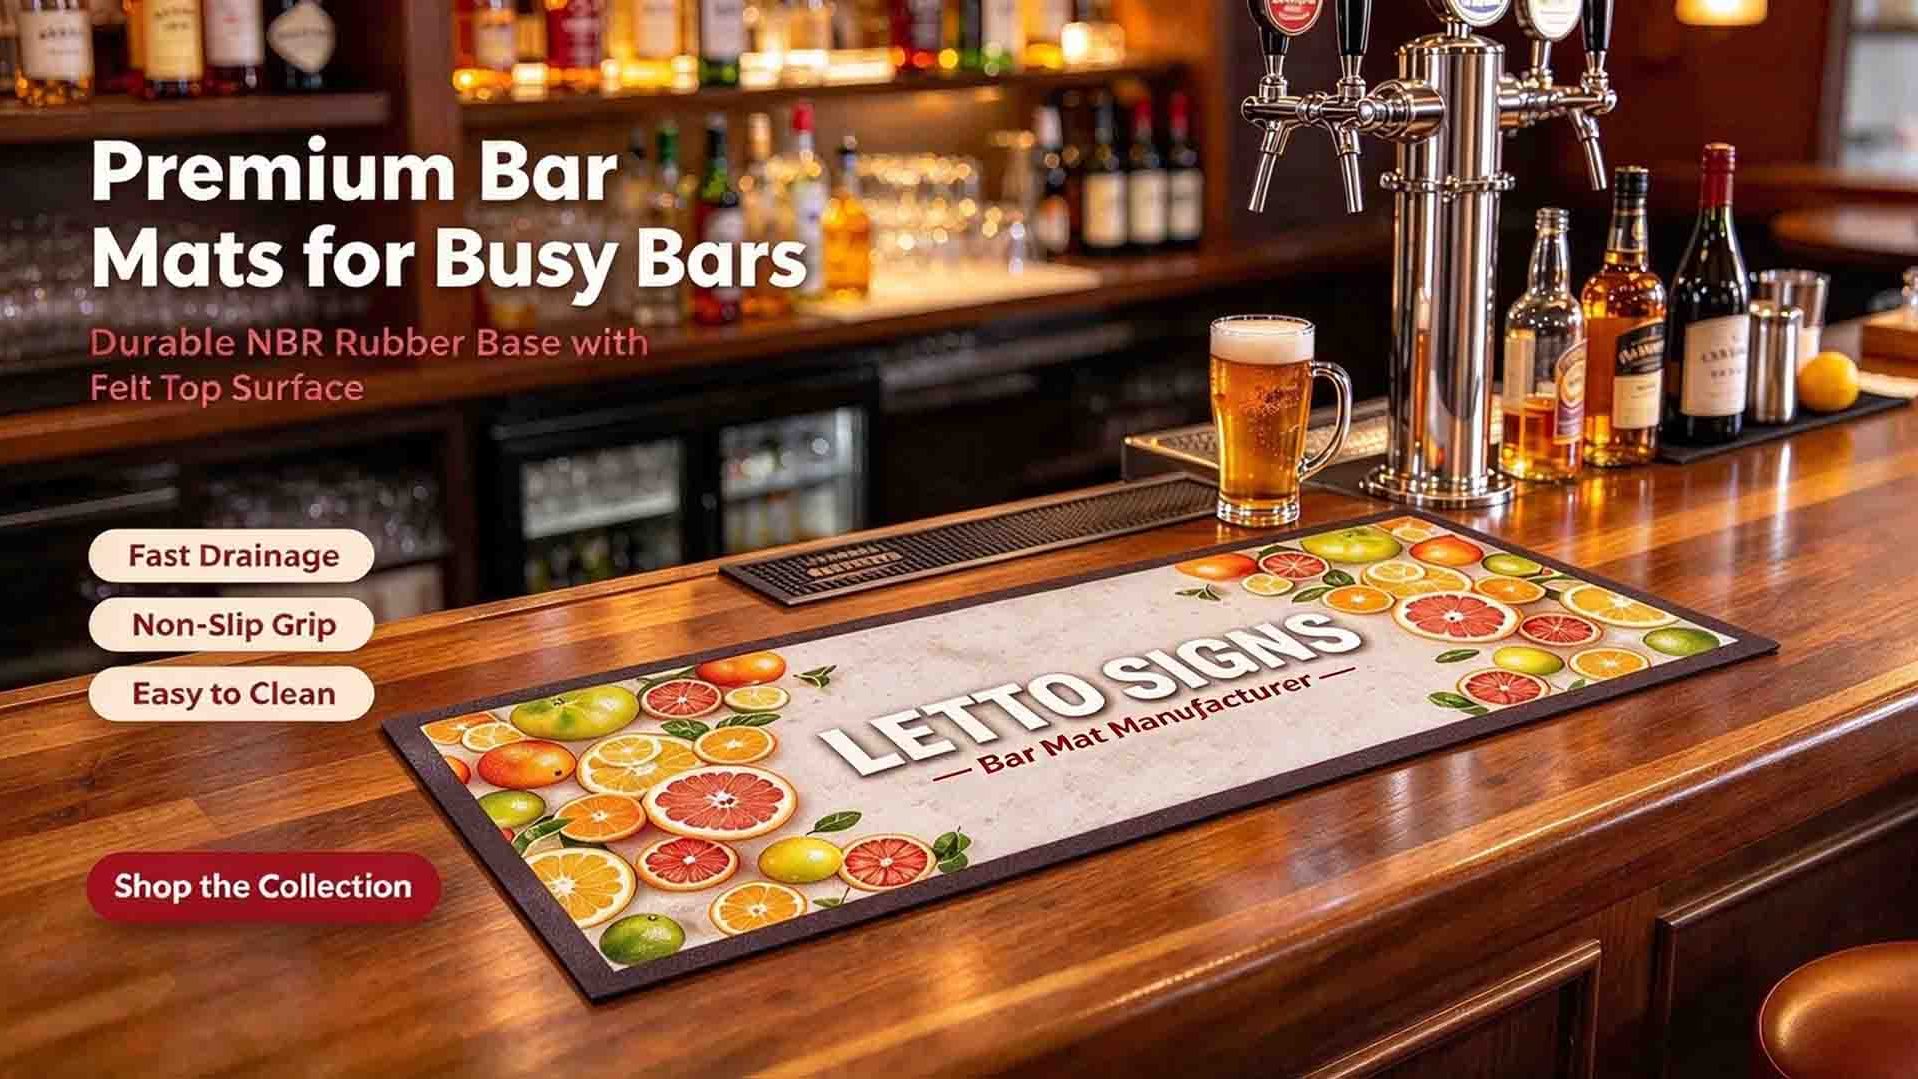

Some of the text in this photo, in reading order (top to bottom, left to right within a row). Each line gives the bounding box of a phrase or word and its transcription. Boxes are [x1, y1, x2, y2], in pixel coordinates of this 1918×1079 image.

[817, 612, 1362, 778] LETTO SIGNS
[977, 671, 1313, 776] Bar Mat Manufacturer
